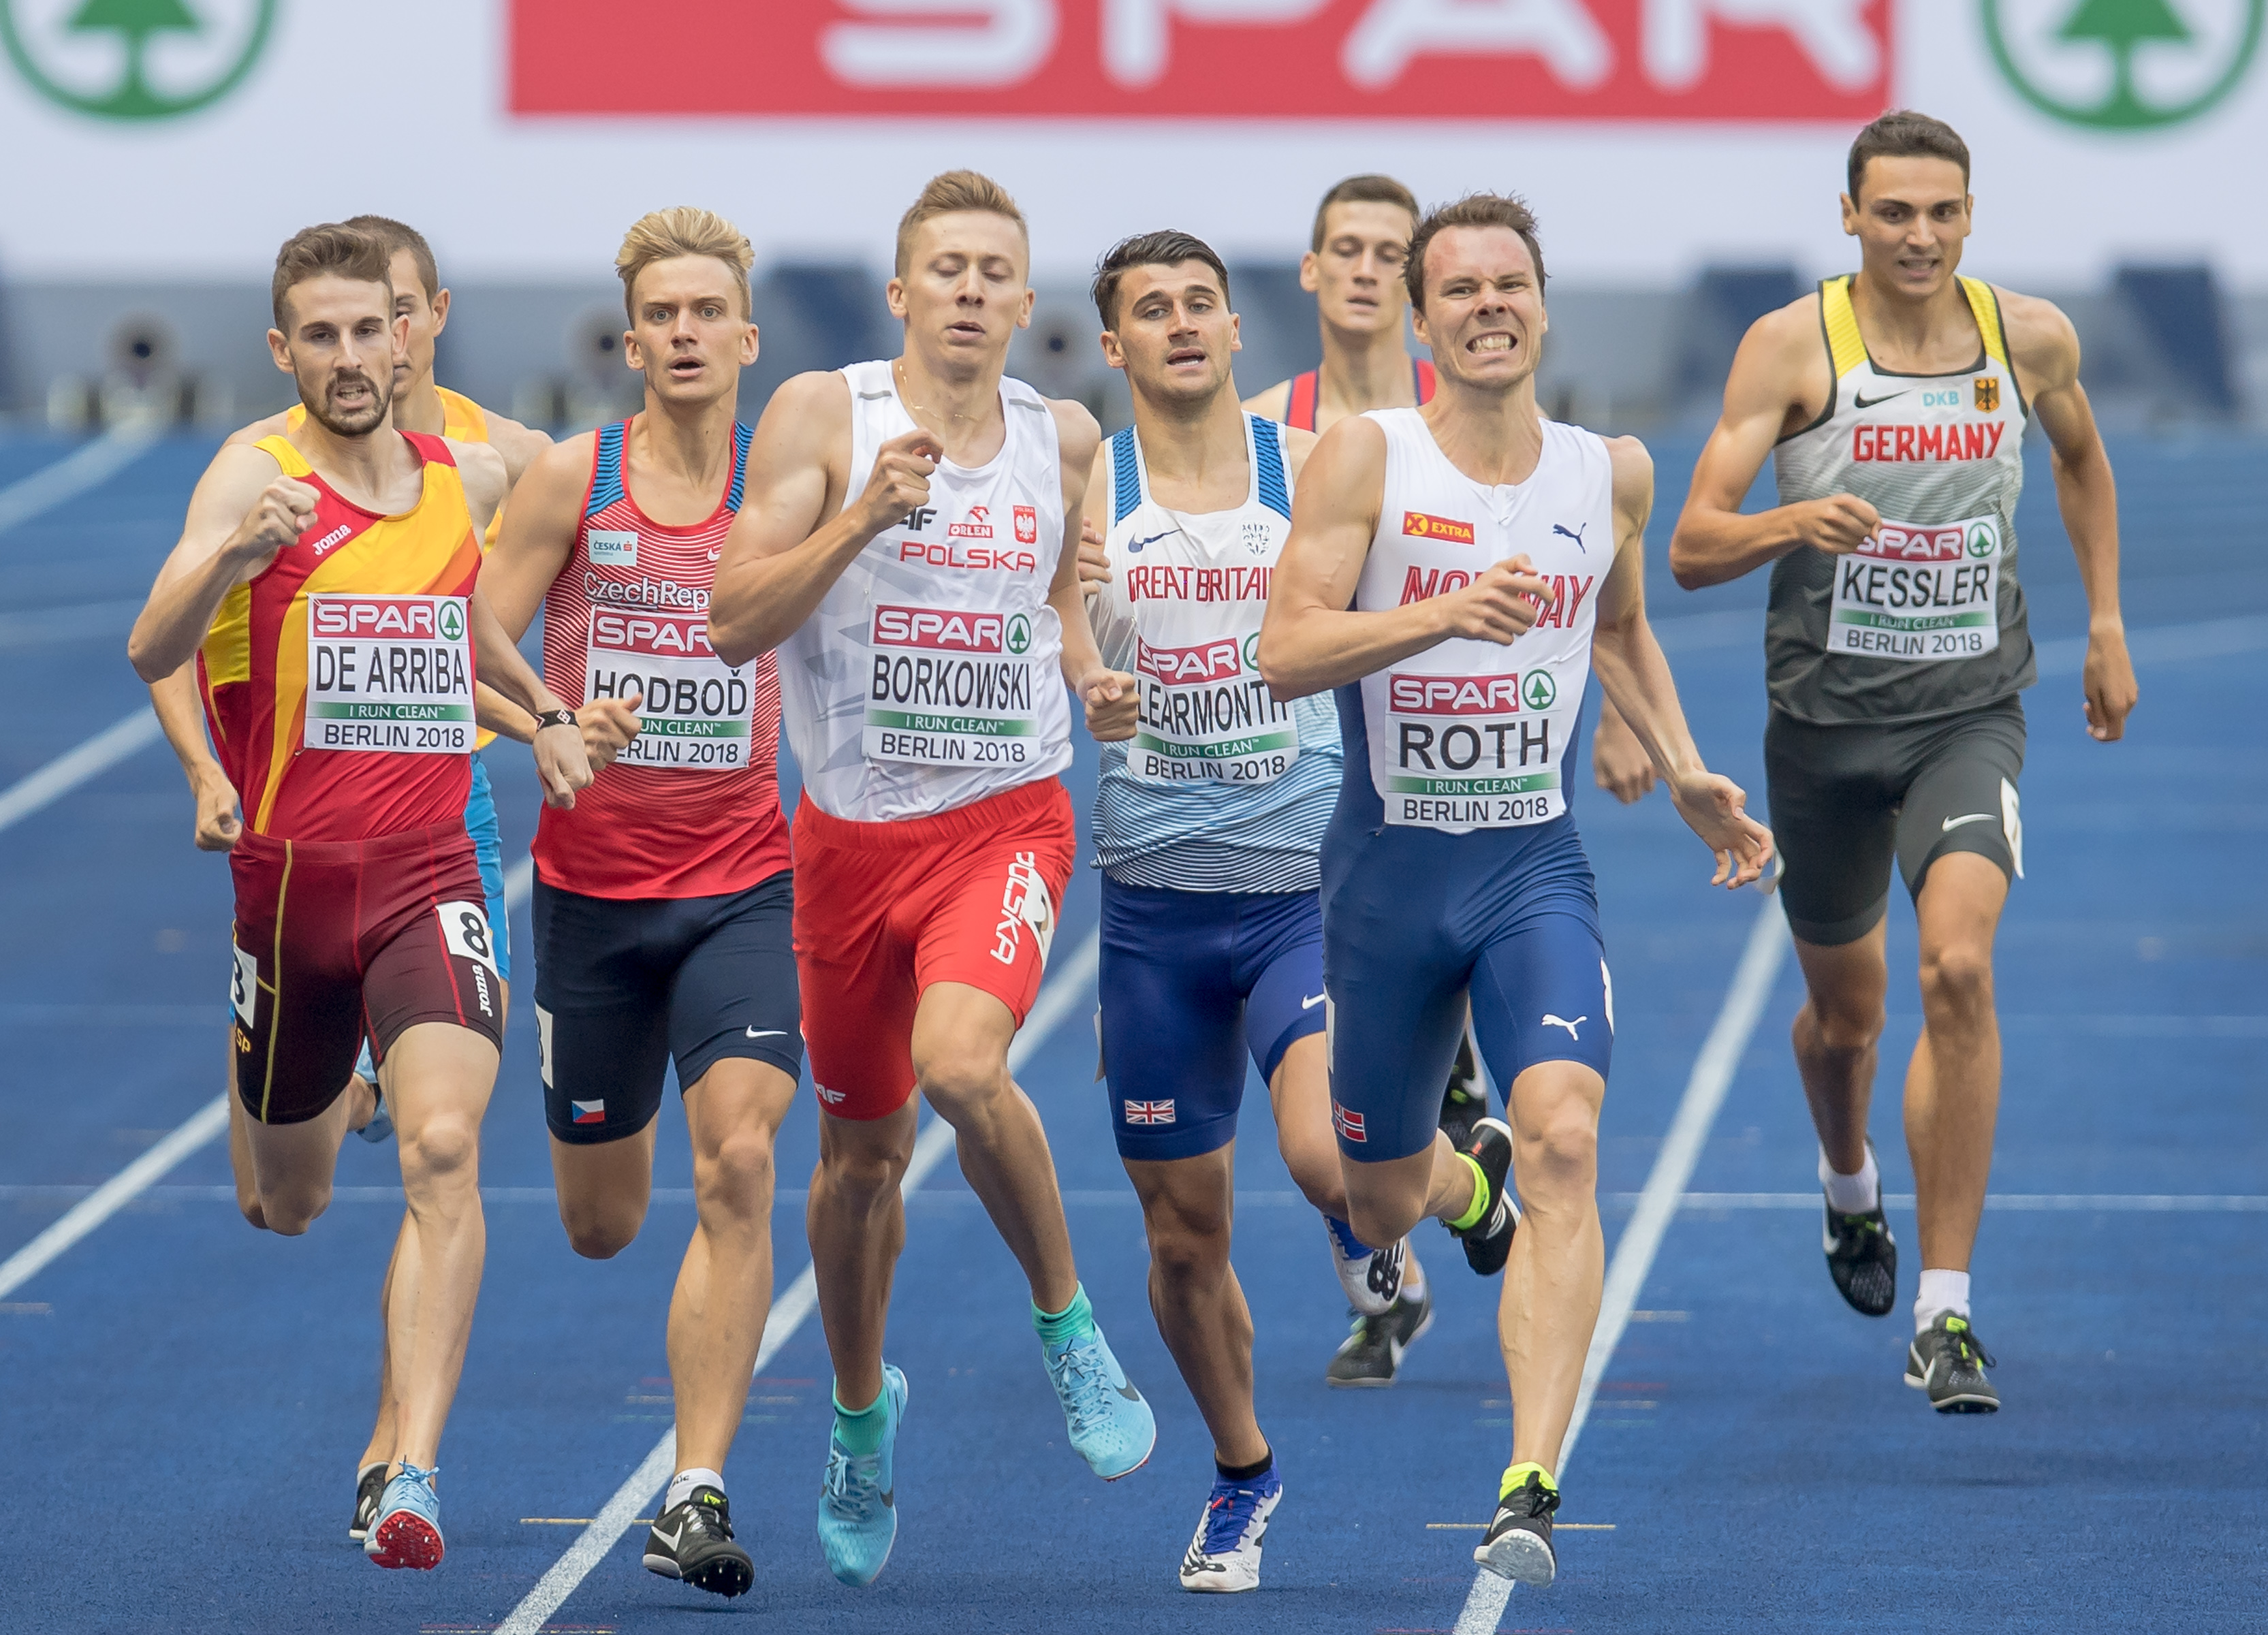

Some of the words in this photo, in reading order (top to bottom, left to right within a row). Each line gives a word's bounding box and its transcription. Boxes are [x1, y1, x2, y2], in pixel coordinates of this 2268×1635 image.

[1922, 390, 1959, 407] DKB
[1853, 420, 2005, 462] GERMANY
[950, 524, 992, 537] ORLEN
[1431, 522, 1472, 539] EXTRA
[593, 540, 622, 552] ČESKÁ
[899, 541, 1036, 574] POLSKA
[1841, 560, 1990, 607] KESSLER
[317, 603, 433, 634] SPAR
[877, 610, 1001, 648] SPAR
[1878, 615, 1908, 629] RUN
[597, 616, 713, 652] SPAR
[1846, 629, 1925, 654] BERLIN
[1932, 633, 1983, 654] 2018
[315, 645, 356, 693] DE
[366, 646, 469, 695] ARRIBA
[1139, 641, 1238, 680] SPAR
[593, 669, 747, 716] HODBOĎ
[871, 654, 1031, 710] BORKOWSKI
[1393, 679, 1516, 710] SPAR
[349, 704, 353, 718] I
[358, 705, 391, 718] RUN
[915, 715, 947, 731] RUN
[324, 724, 409, 747] BERLIN
[415, 727, 464, 748] 2018
[640, 719, 663, 733] UN
[616, 739, 680, 762] RLIN
[687, 742, 738, 763] 2018
[881, 731, 965, 761] BERLIN
[973, 740, 1026, 763] 2018
[1167, 744, 1201, 757] RUN
[1400, 718, 1549, 771] ROTH
[1145, 754, 1225, 780] BERLIN
[1230, 755, 1285, 780] 2018
[1435, 781, 1468, 793] RUN
[1403, 798, 1489, 822] BERLIN
[1498, 797, 1549, 821] 2018
[459, 911, 489, 958] 8
